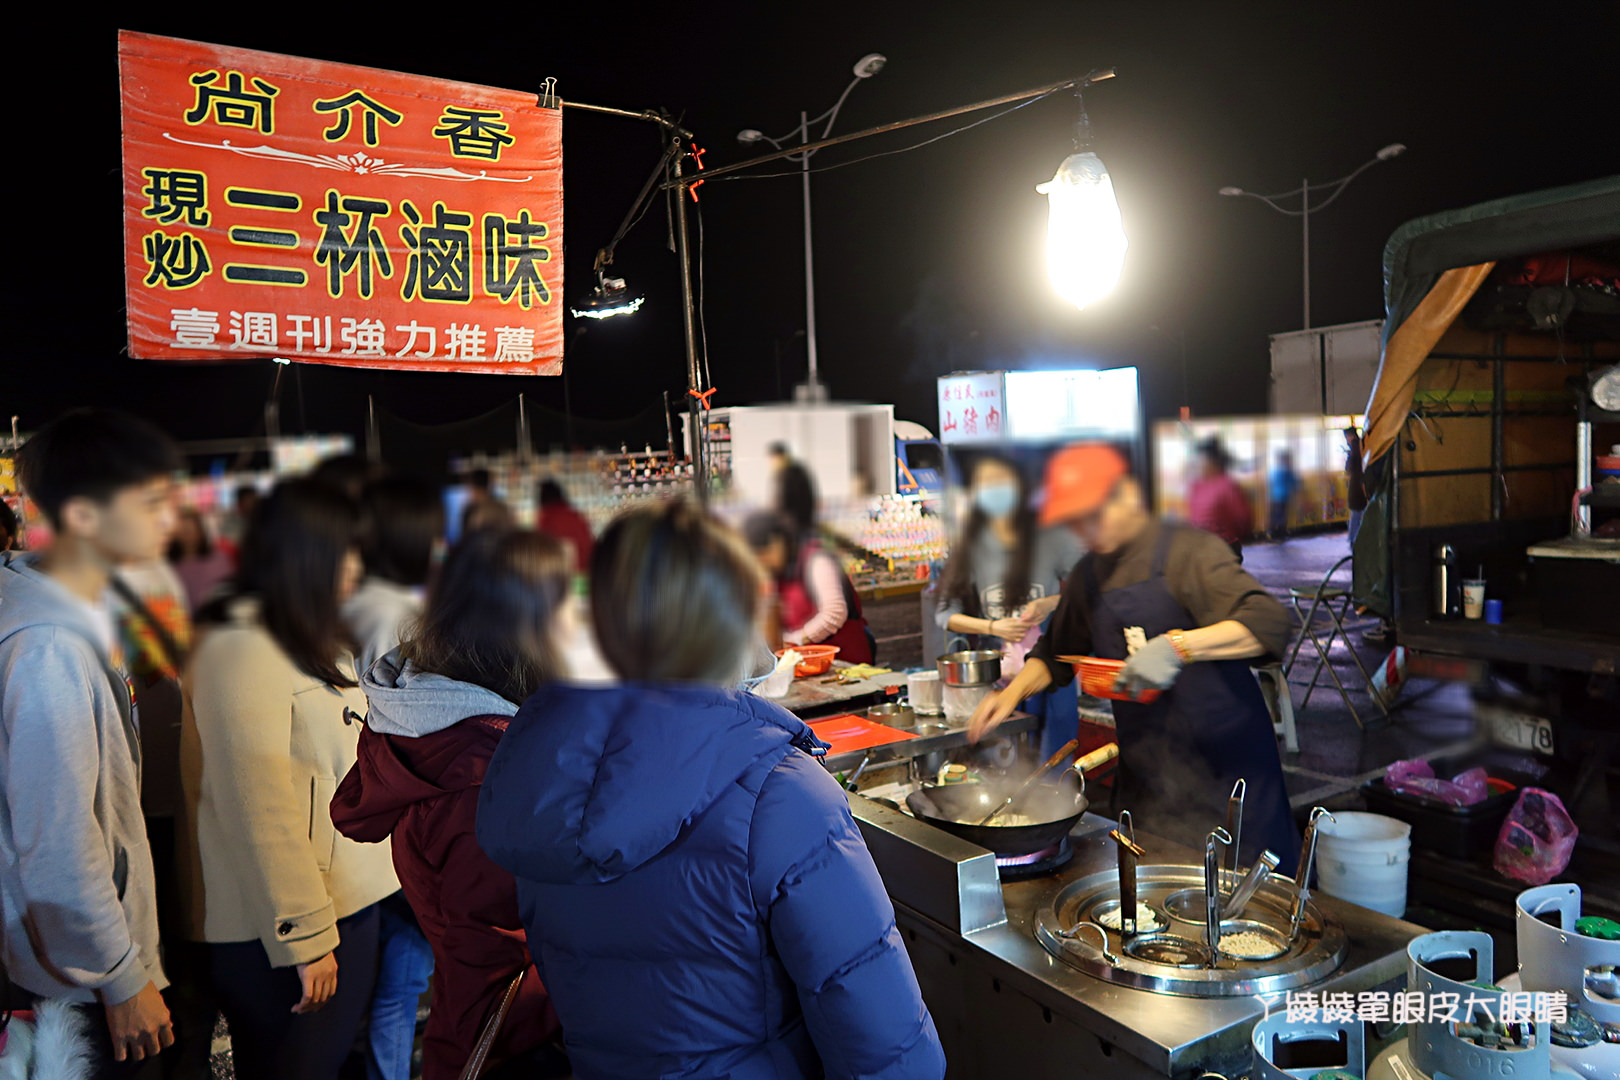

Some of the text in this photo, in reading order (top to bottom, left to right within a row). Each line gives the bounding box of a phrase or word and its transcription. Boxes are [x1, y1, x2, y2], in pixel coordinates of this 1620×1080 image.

[184, 70, 514, 161] 尚介香
[142, 166, 212, 290] 現炒
[222, 187, 552, 310] 三杯滷味
[169, 307, 535, 363] 壹週刊強力推薦
